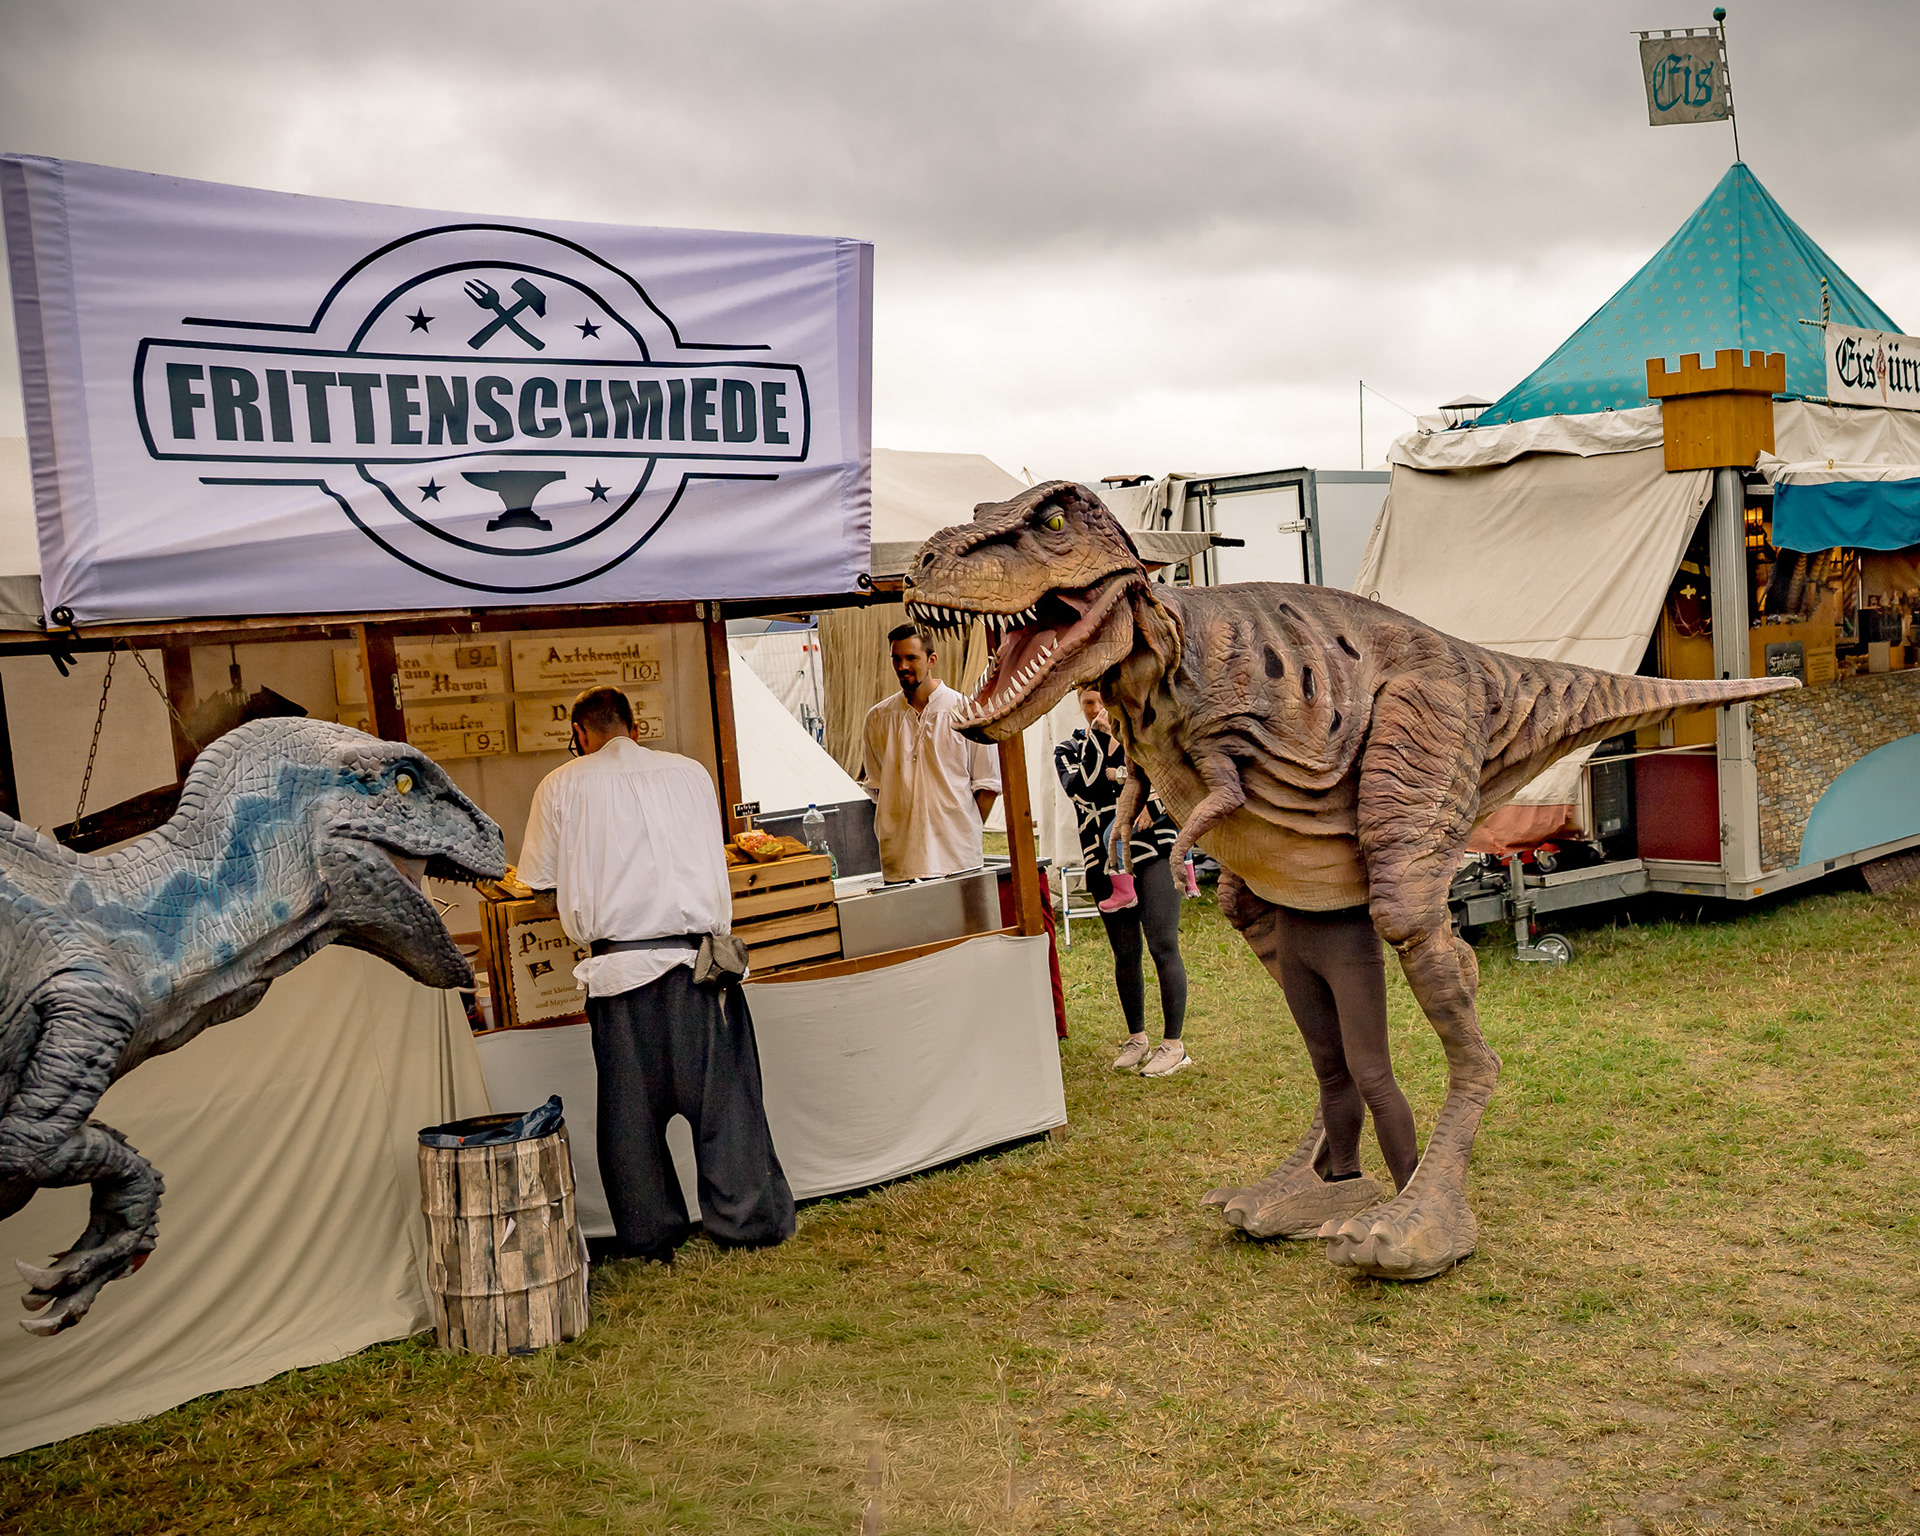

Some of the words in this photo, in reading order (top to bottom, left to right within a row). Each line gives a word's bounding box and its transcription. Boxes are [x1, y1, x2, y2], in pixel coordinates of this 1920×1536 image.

[1653, 53, 1714, 112] Eis
[165, 362, 791, 446] FRITTENSCHMIEDE
[546, 643, 641, 665] Aztekengold
[431, 673, 488, 695] Hawai
[477, 733, 501, 751] 9,-
[518, 931, 578, 957] Pirat
[535, 1000, 548, 1009] und
[550, 998, 568, 1007] Mayo
[569, 994, 584, 1003] oder
